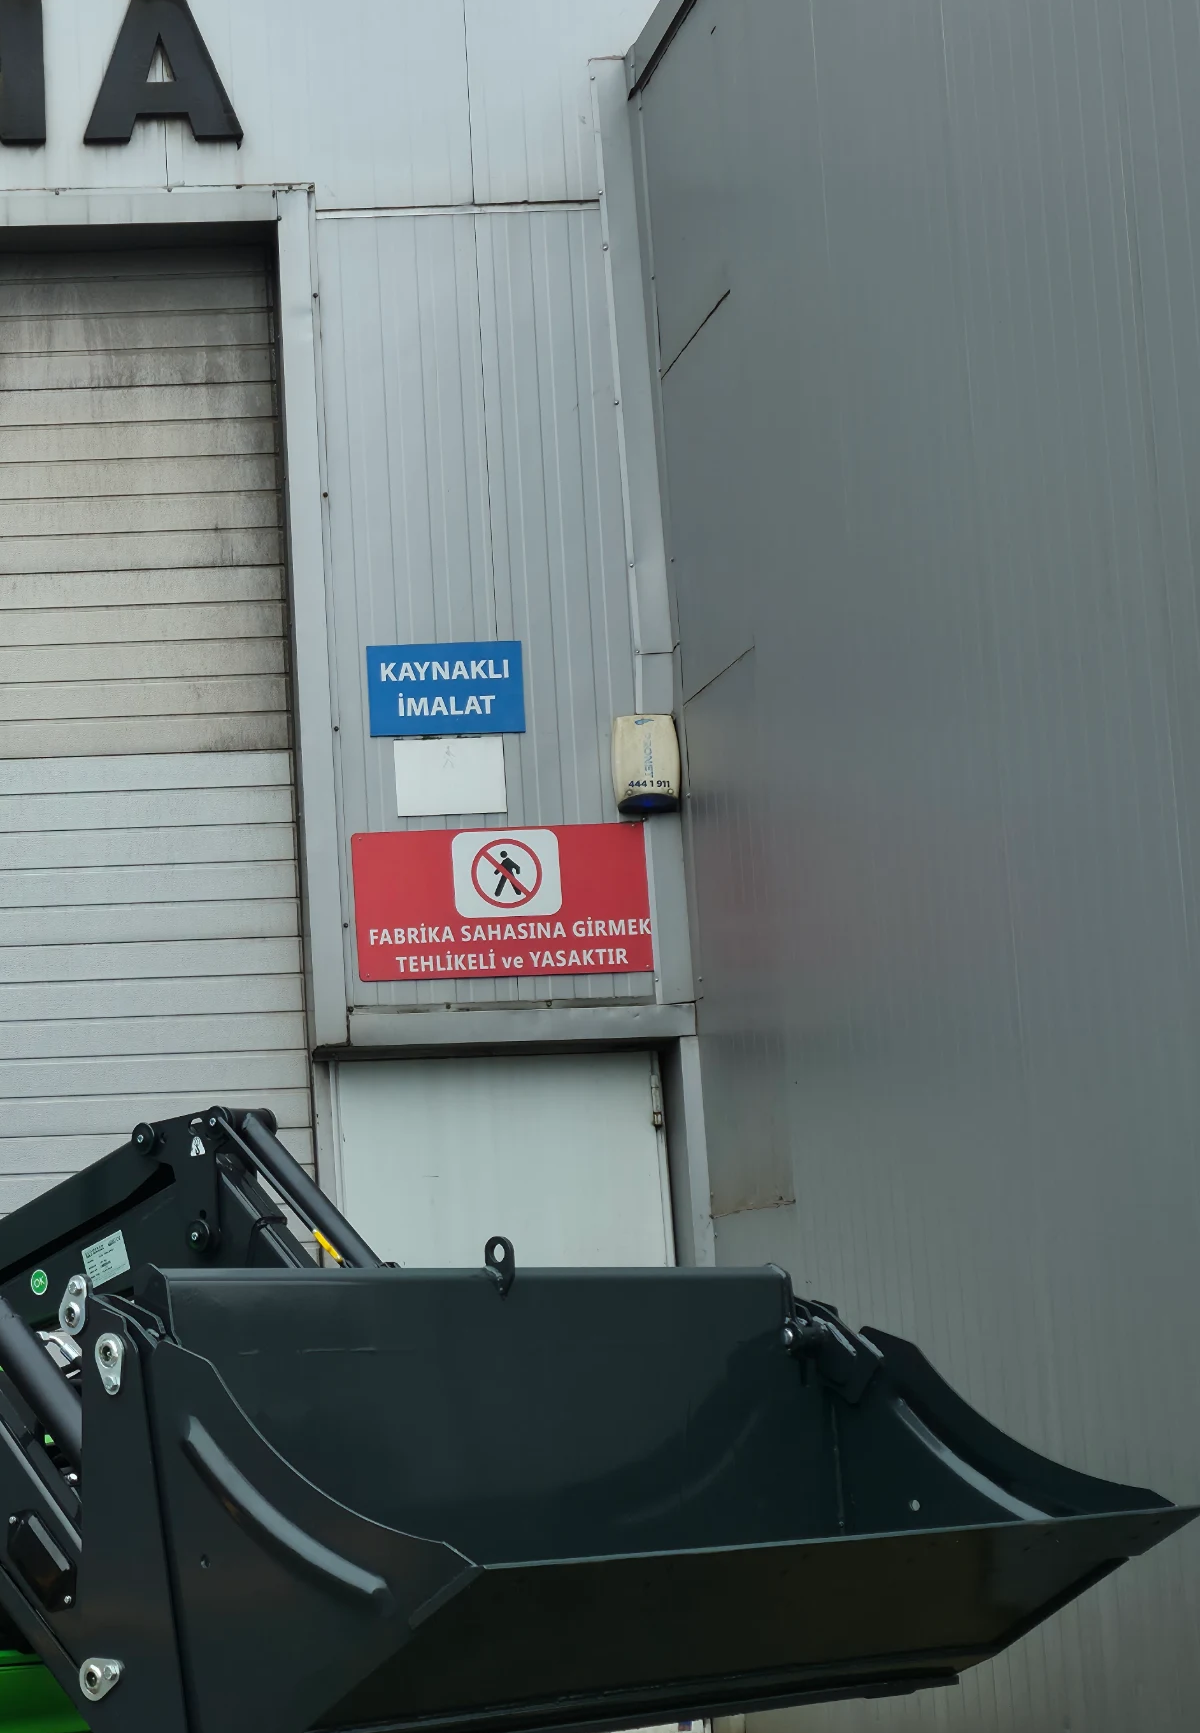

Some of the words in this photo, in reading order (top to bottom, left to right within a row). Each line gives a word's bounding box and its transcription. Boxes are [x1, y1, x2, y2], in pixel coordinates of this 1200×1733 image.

[380, 659, 510, 682] KAYNAKLI
[398, 693, 496, 717] İMALAT
[628, 780, 648, 788] 444
[650, 780, 654, 788] 1
[656, 780, 670, 788] 911
[369, 923, 455, 945] FABRİKA
[461, 921, 567, 942] SAHASINA
[572, 916, 652, 938] GİRMEK
[395, 949, 497, 973] TEHLİKELİ
[501, 955, 523, 969] ve
[529, 947, 629, 968] YASAKTIR
[33, 1275, 45, 1288] OK
